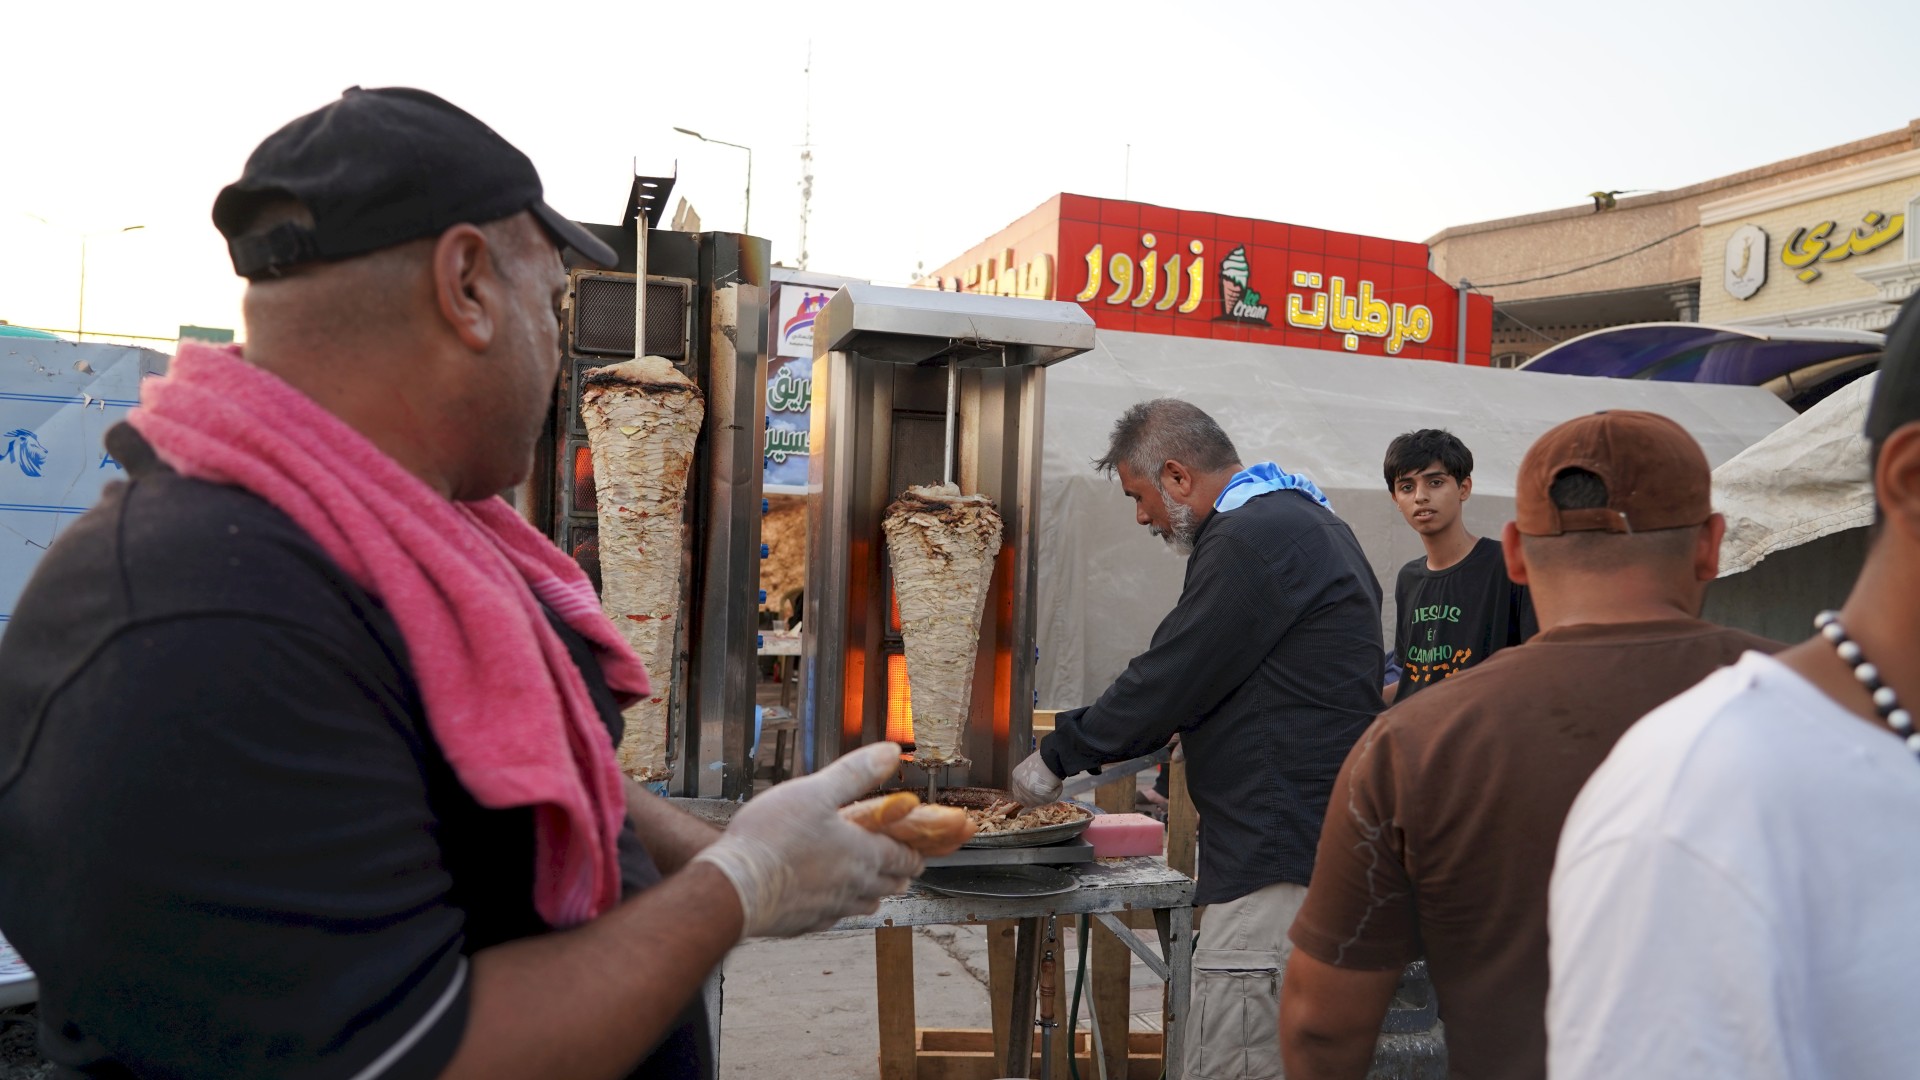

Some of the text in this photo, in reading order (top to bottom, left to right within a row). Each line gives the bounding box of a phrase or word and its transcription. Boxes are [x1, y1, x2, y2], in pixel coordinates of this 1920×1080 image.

[1076, 233, 1433, 354] مرطبات زرزور
[1233, 299, 1268, 320] Cream
[767, 367, 811, 412] ريق
[764, 428, 810, 463] سير
[1413, 605, 1461, 623] JESUS
